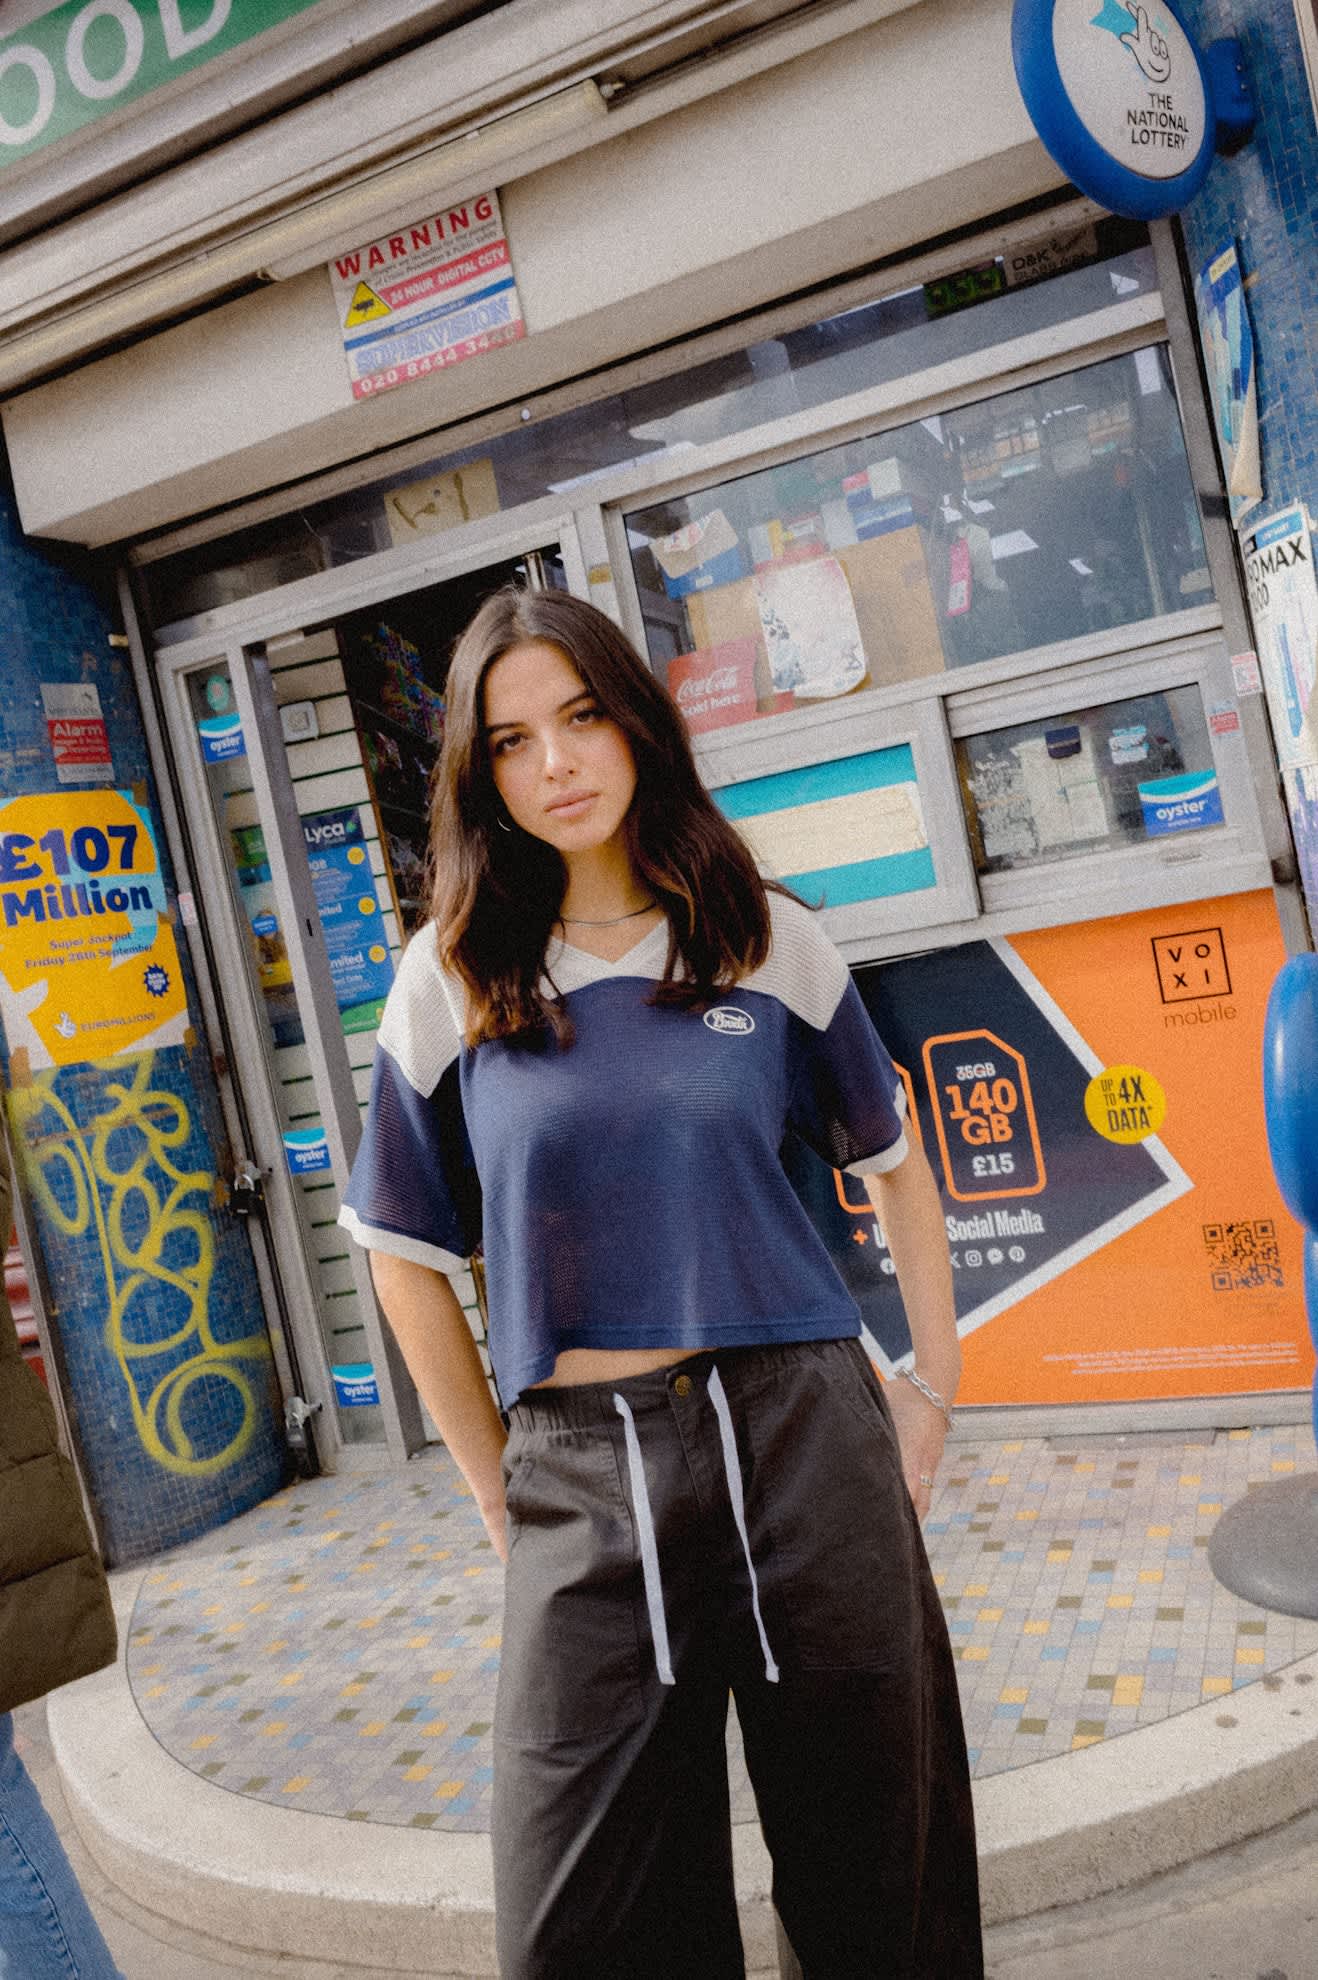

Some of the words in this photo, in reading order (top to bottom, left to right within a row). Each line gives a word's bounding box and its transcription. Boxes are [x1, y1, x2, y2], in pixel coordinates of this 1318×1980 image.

[1147, 92, 1173, 111] THE
[1127, 109, 1189, 132] NATIONAL
[1131, 128, 1187, 150] LOTTERY
[335, 196, 493, 280] WARNING
[405, 276, 434, 298] HOUR
[438, 262, 477, 286] DIGITAL
[477, 247, 506, 268] CCTV
[360, 369, 399, 393] 020
[406, 348, 458, 377] 8444
[54, 721, 102, 737] Alarm
[210, 735, 241, 753] oyster
[1156, 800, 1208, 821] oyster
[304, 822, 345, 844] Lyca
[0, 825, 138, 884] £107
[2, 880, 153, 928] Million
[49, 938, 83, 951] Super
[88, 932, 132, 945] Jackpot
[25, 955, 65, 970] Friday
[98, 943, 153, 958] September
[81, 1012, 155, 1032] EUROMILLIONS
[1164, 1001, 1237, 1028] mobile
[1101, 1078, 1113, 1092] UP
[1119, 1075, 1146, 1104] 4X
[945, 1077, 1018, 1120] 140
[1103, 1092, 1117, 1106] TO
[961, 1112, 1014, 1146] GB
[295, 1150, 325, 1164] oyster
[972, 1152, 1015, 1177] £15
[945, 1211, 995, 1242] Social
[995, 1208, 1045, 1237] Media
[344, 1385, 375, 1398] oyster
